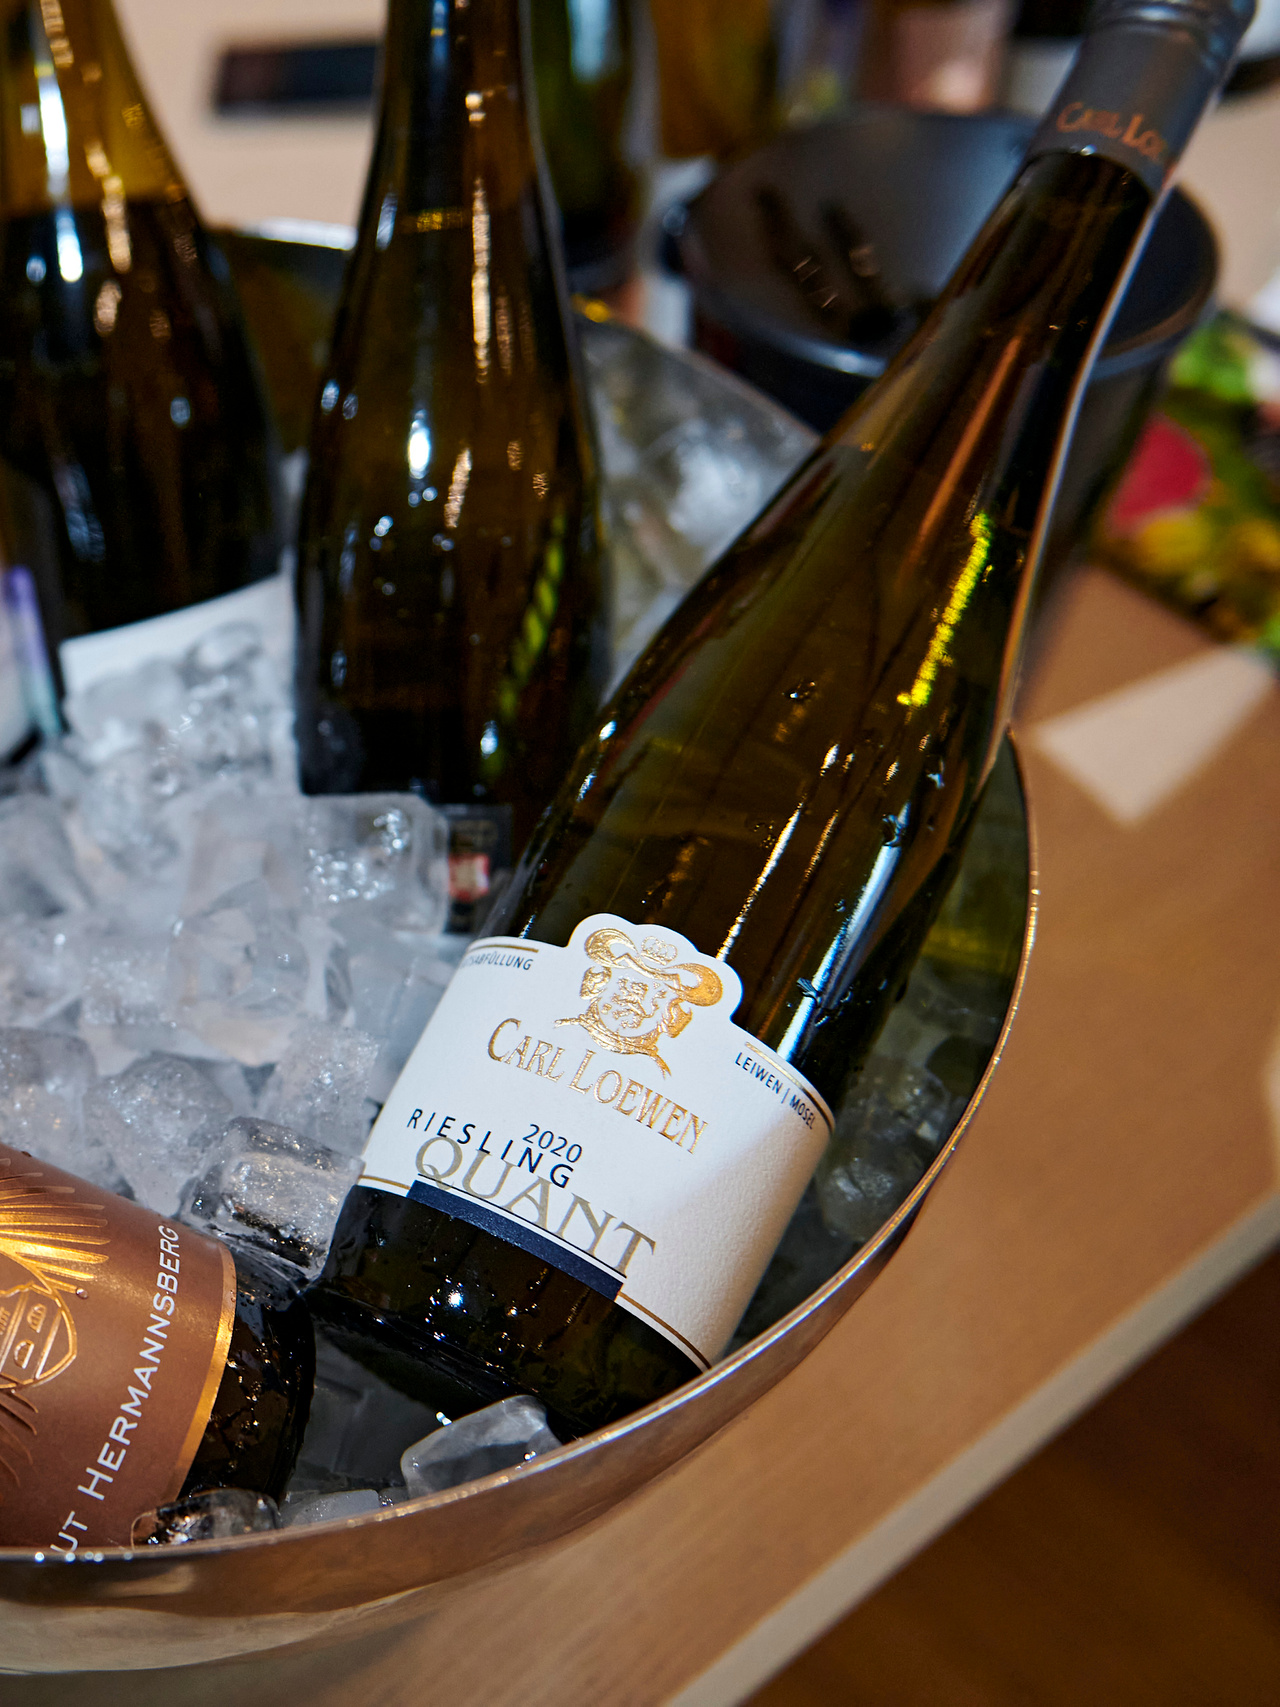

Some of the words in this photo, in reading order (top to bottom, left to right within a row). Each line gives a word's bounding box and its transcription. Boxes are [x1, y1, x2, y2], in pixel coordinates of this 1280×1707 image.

[487, 1017, 566, 1082] CARL
[567, 1048, 708, 1155] LOEWEN
[734, 1051, 784, 1095] LEIWEN
[789, 1094, 816, 1130] MOSEL
[407, 1108, 575, 1189] RIESLING
[522, 1123, 583, 1164] 2020
[415, 1136, 657, 1276] QUANT
[49, 1510, 88, 1553] UT
